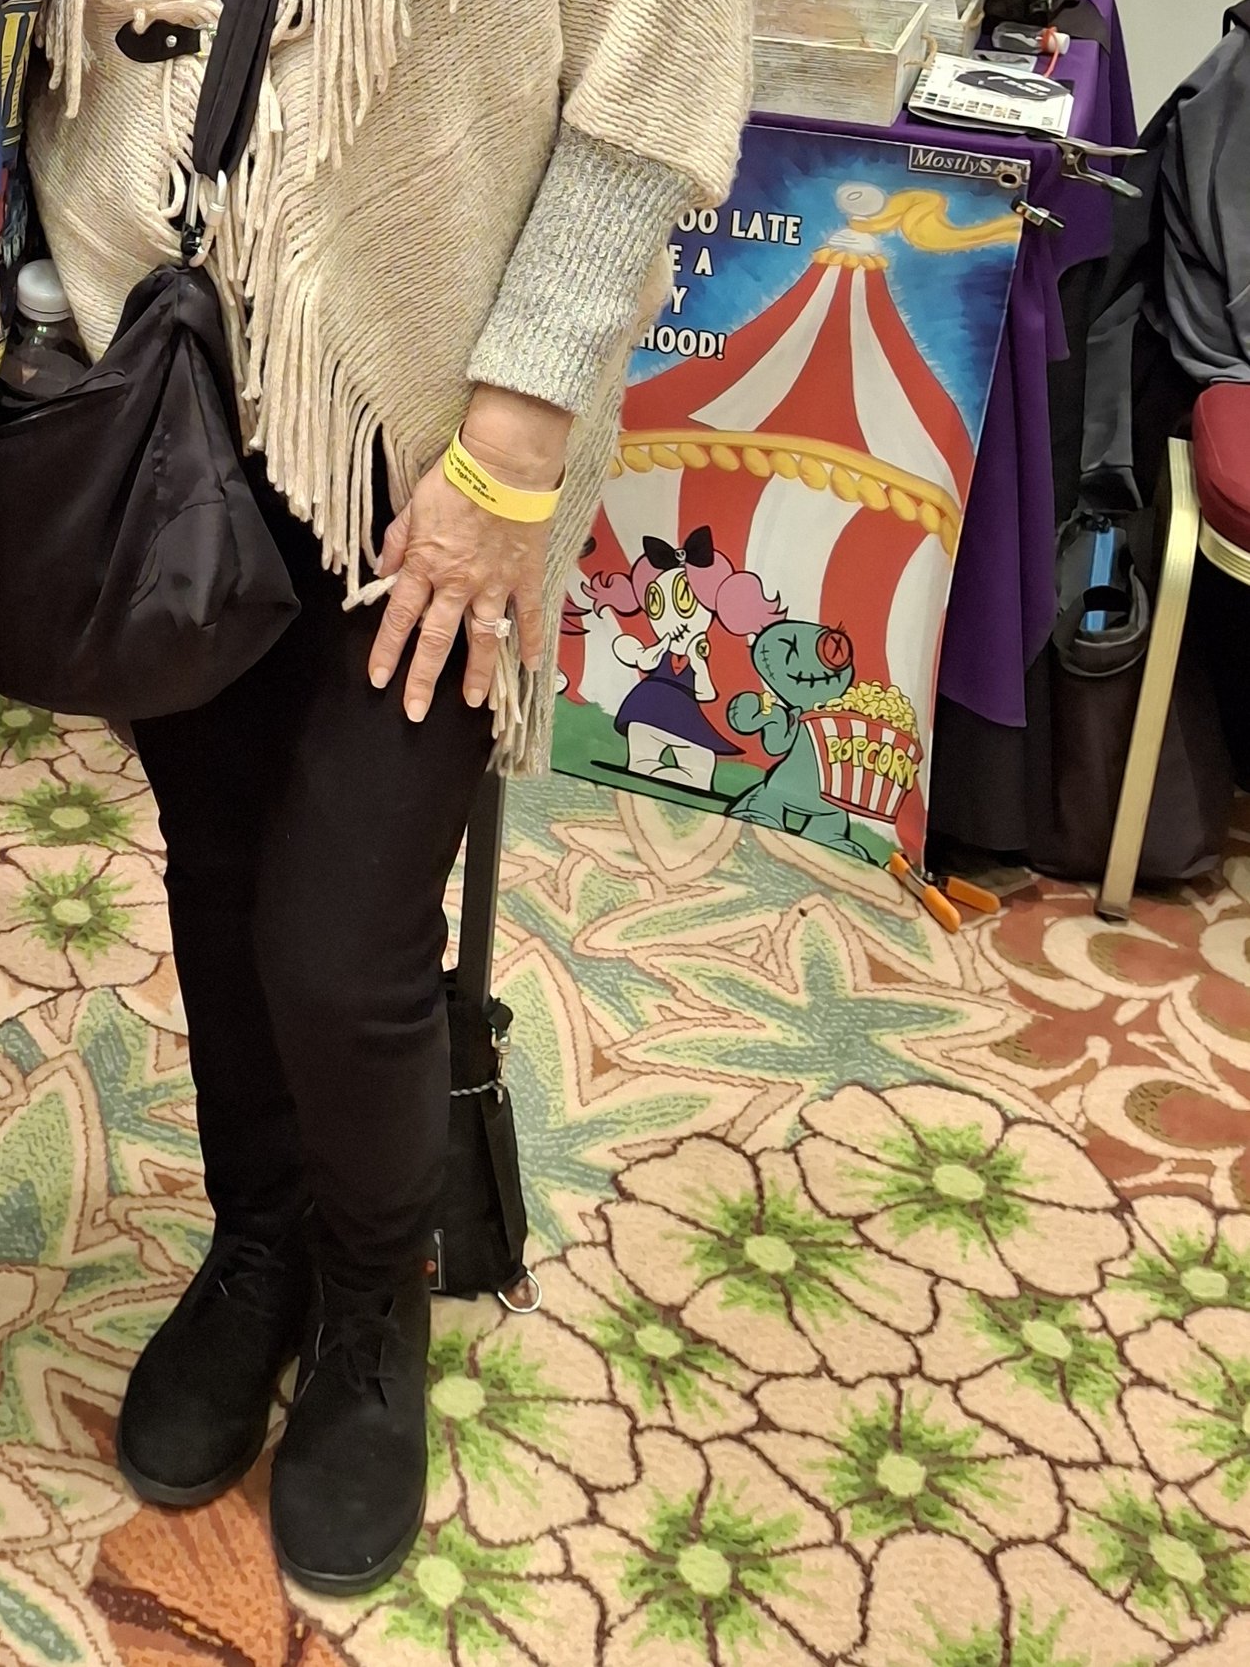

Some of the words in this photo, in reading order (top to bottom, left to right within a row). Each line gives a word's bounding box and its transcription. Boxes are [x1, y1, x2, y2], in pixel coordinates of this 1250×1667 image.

[731, 209, 802, 245] LATE
[693, 247, 714, 276] A
[825, 735, 919, 791] POPCORN
